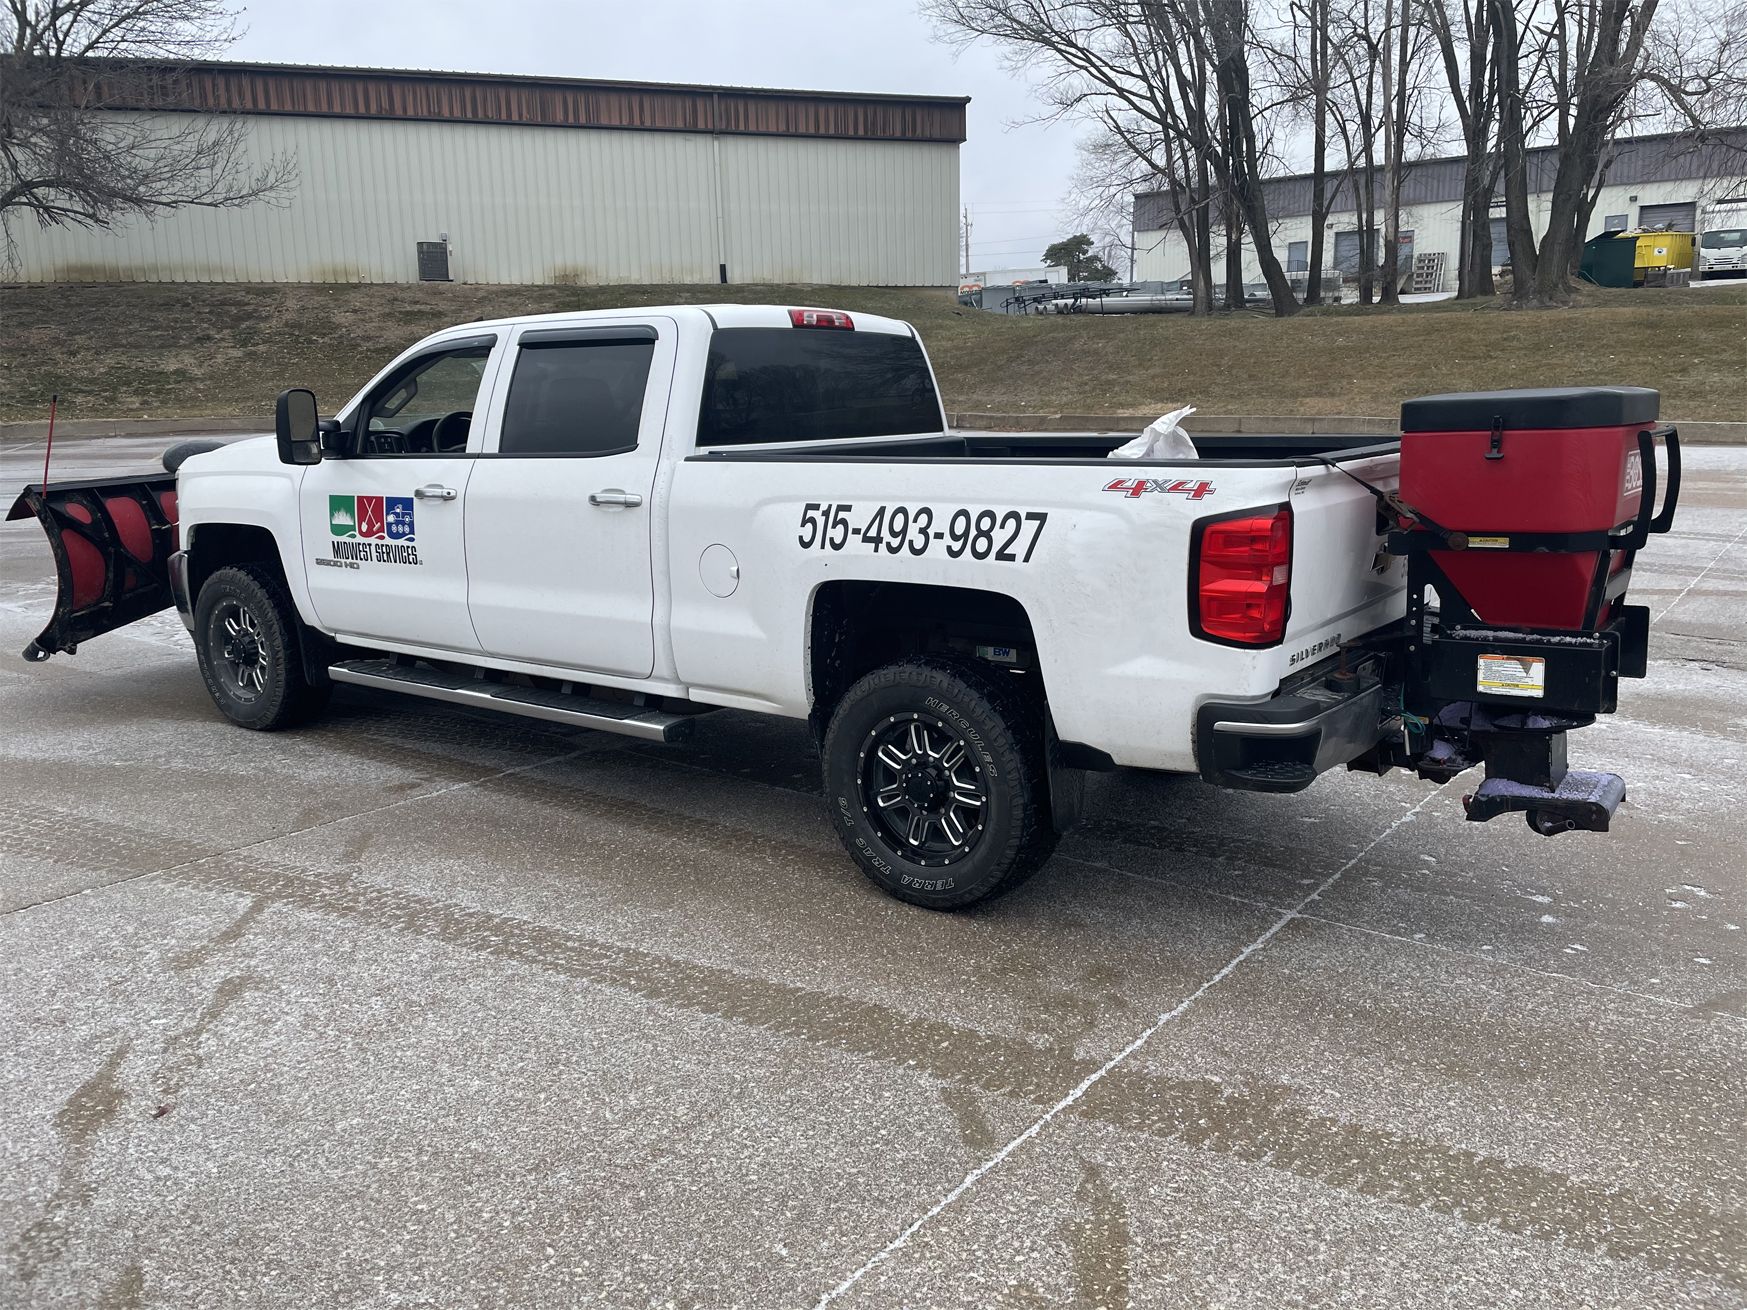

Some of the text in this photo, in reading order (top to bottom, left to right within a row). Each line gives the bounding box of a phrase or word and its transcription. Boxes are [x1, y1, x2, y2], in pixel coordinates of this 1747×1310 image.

[798, 503, 1048, 563] 515-493-9827
[332, 541, 418, 565] MIDWEST SERVICES
[925, 697, 997, 777] HERCULES
[855, 837, 892, 875] TRAC
[901, 874, 955, 891] TERRA
